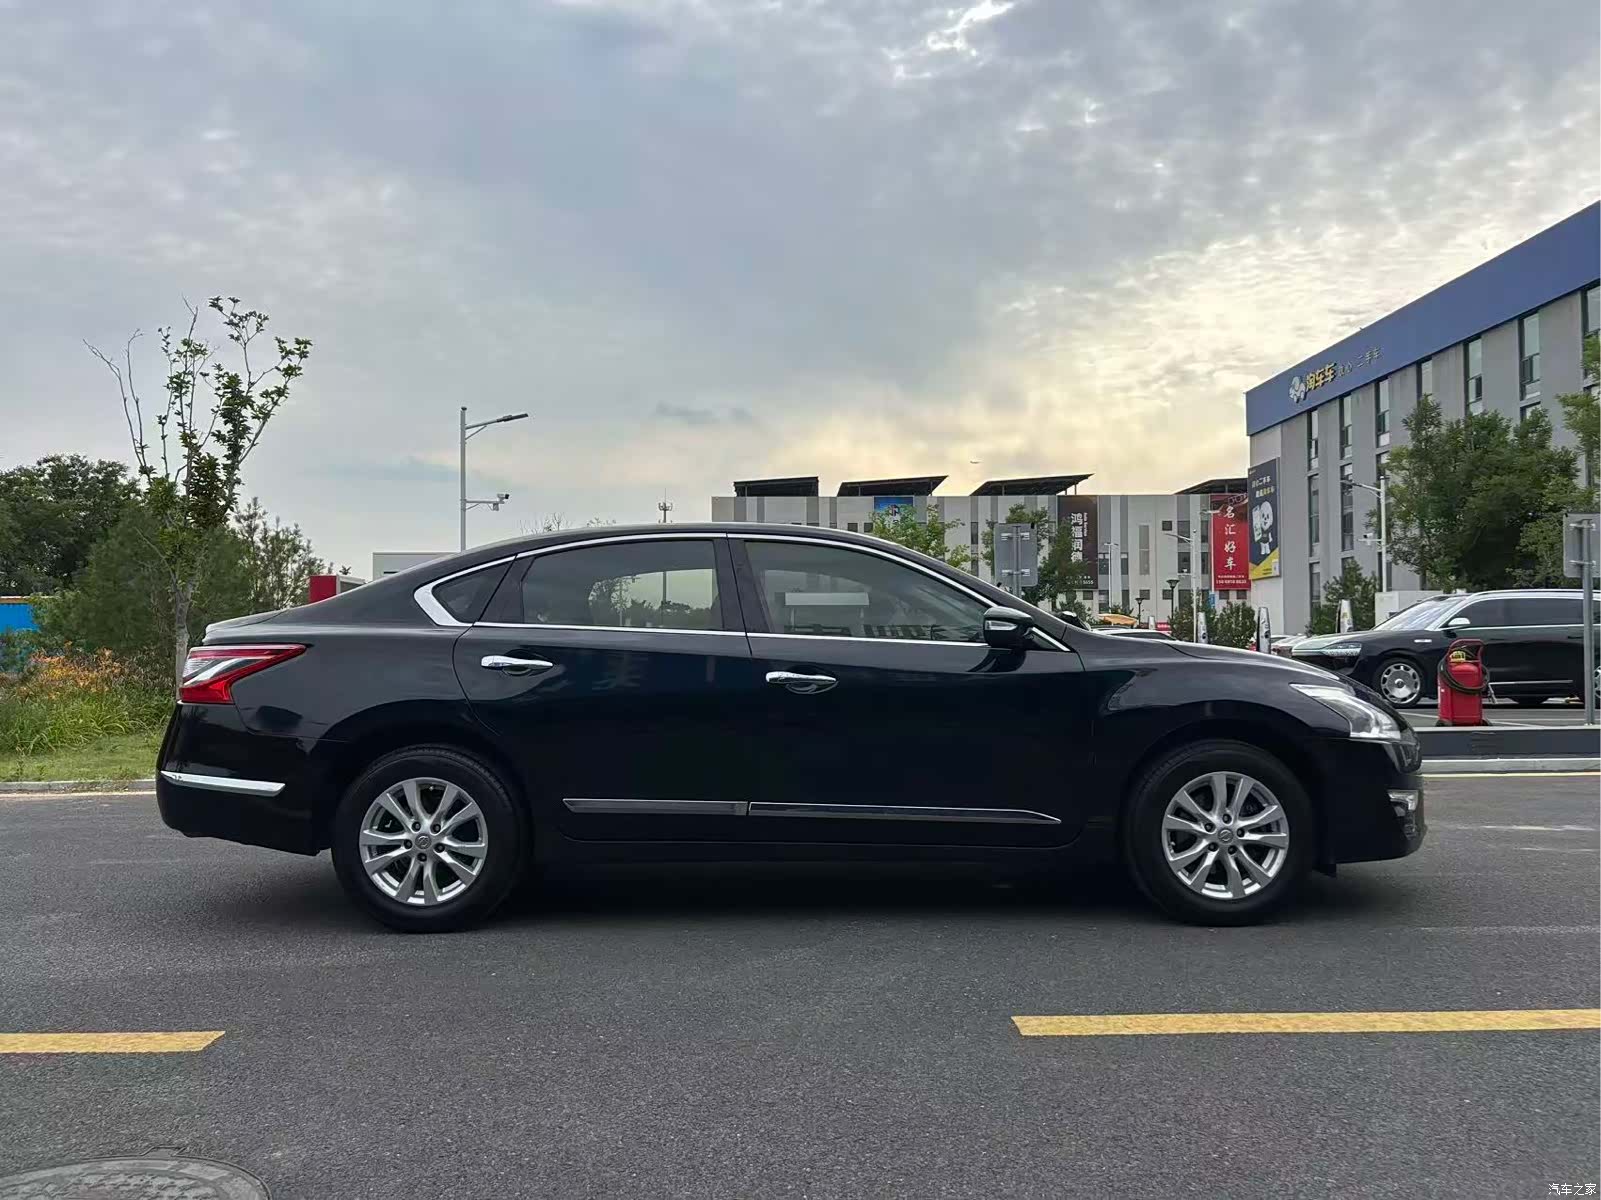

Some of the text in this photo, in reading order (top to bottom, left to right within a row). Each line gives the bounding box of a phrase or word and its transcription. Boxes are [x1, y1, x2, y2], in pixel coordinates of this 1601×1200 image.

[1305, 362, 1337, 392] 淘车车
[1223, 505, 1237, 570] 名汇好车
